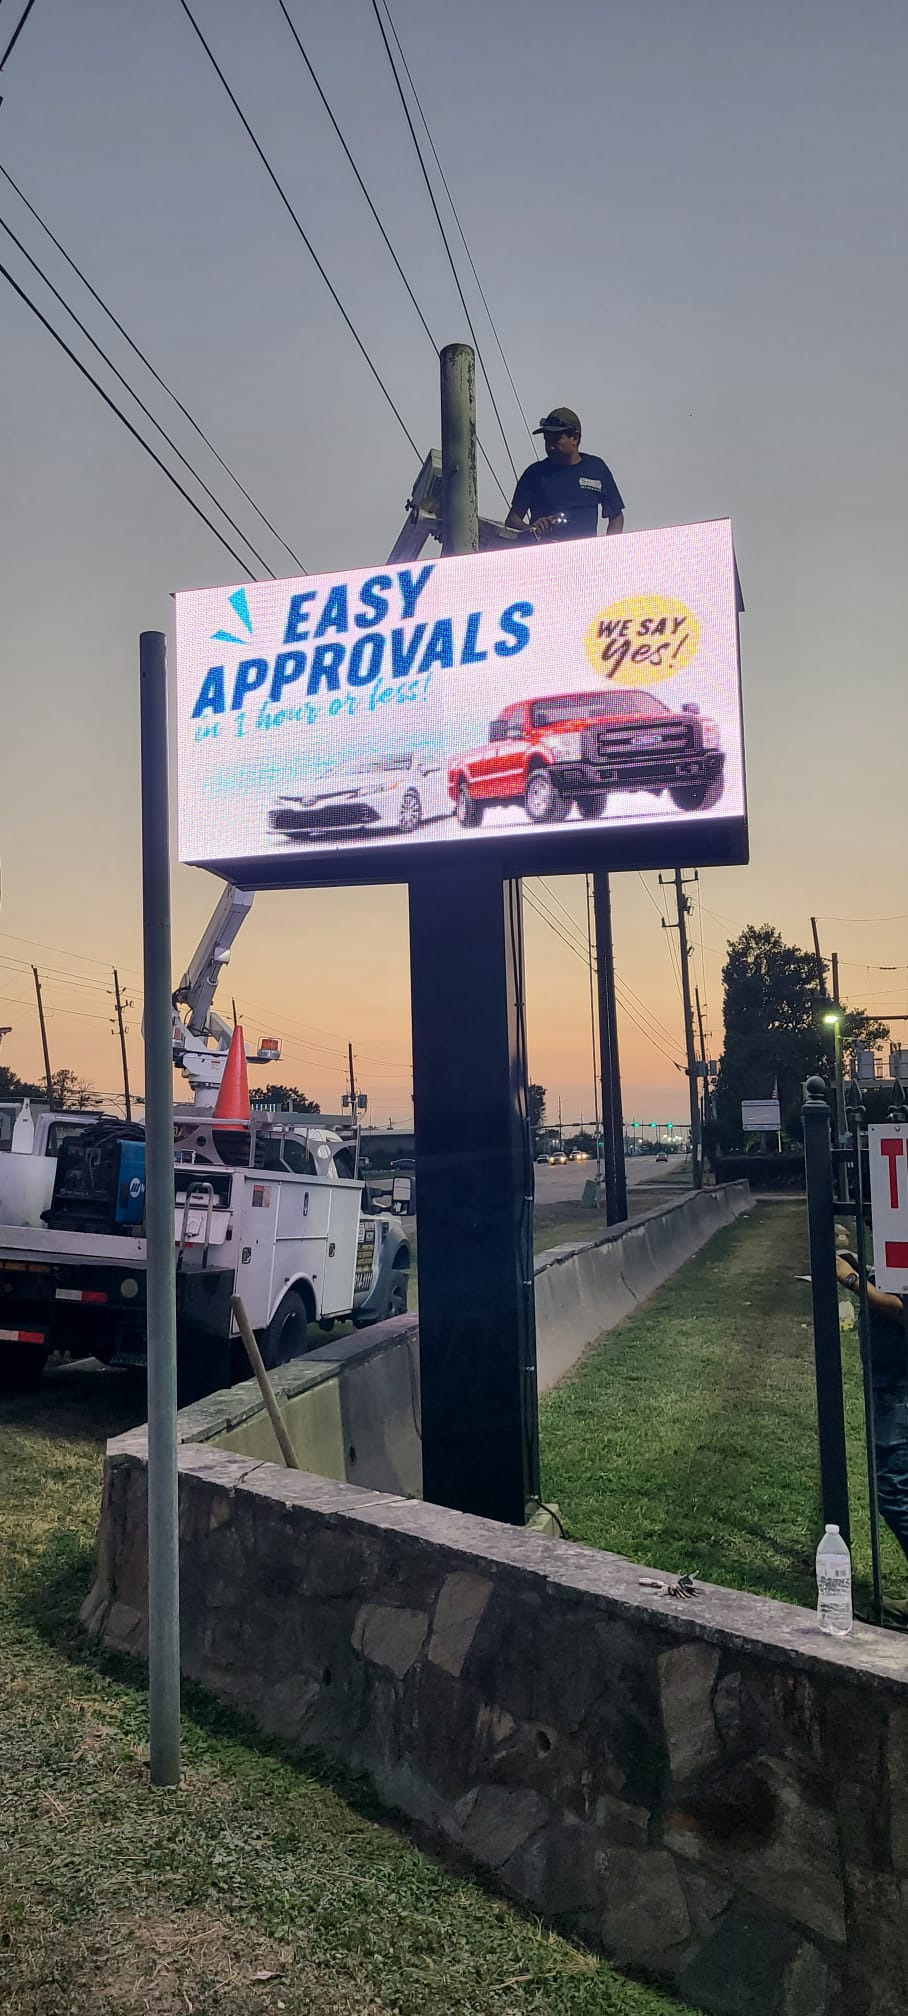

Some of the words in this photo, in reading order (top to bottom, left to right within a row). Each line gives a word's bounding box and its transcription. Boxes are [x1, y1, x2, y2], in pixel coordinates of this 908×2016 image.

[284, 564, 435, 644] EASY
[597, 619, 633, 638] WE
[636, 616, 687, 636] SAY
[191, 600, 535, 718] APPROVALS
[236, 712, 246, 738] 1
[257, 700, 320, 731] hour
[328, 691, 357, 716] or
[368, 671, 432, 712] less!
[880, 1138, 908, 1208] T
